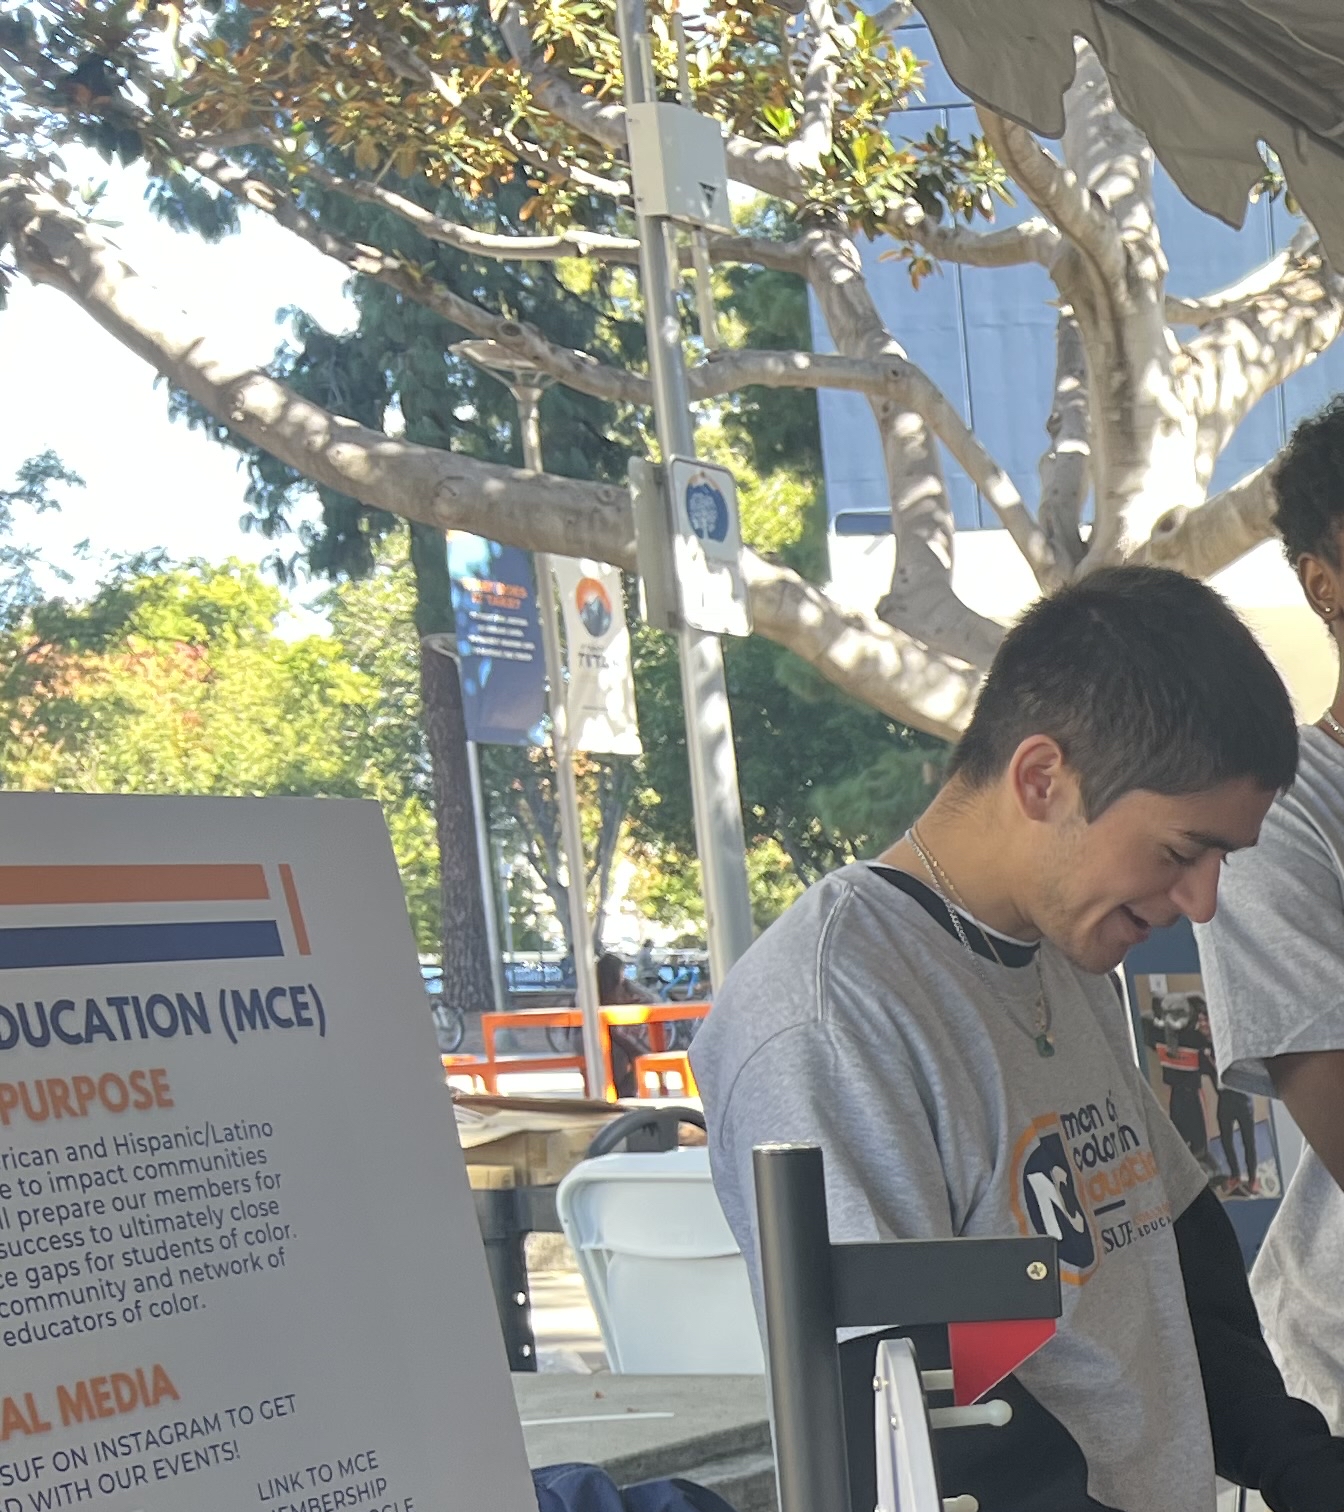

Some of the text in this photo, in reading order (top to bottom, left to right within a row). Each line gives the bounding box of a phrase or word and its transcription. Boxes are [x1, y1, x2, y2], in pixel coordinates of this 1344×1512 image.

[219, 983, 326, 1045] (MCE)
[0, 1067, 175, 1126] PURPOSE
[1060, 1103, 1105, 1140] men
[66, 1136, 108, 1162] and
[113, 1120, 274, 1157] Hispanic/Latino
[17, 1199, 106, 1232] prepare
[111, 1191, 147, 1213] our
[153, 1176, 252, 1207] members
[255, 1171, 282, 1191] for
[18, 1176, 42, 1198] to
[47, 1164, 128, 1194] impact
[133, 1146, 268, 1181] communities
[0, 1199, 280, 1259] success to ultimately close
[25, 1258, 81, 1289] gaps
[85, 1250, 115, 1274] for
[121, 1236, 214, 1268] students
[219, 1227, 239, 1250] of
[243, 1222, 298, 1247] color.
[0, 1277, 127, 1319] community
[133, 1265, 173, 1294] and
[179, 1251, 264, 1285] network
[267, 1247, 286, 1268] of
[3, 1293, 207, 1348] educators of color.
[55, 1363, 181, 1427] MEDIA
[0, 1394, 297, 1487] SUF ON INSTAGRAM TO GET
[98, 1465, 149, 1494] OUR
[153, 1440, 241, 1481] EVENTS!
[256, 1450, 379, 1502] LINK TO MCE
